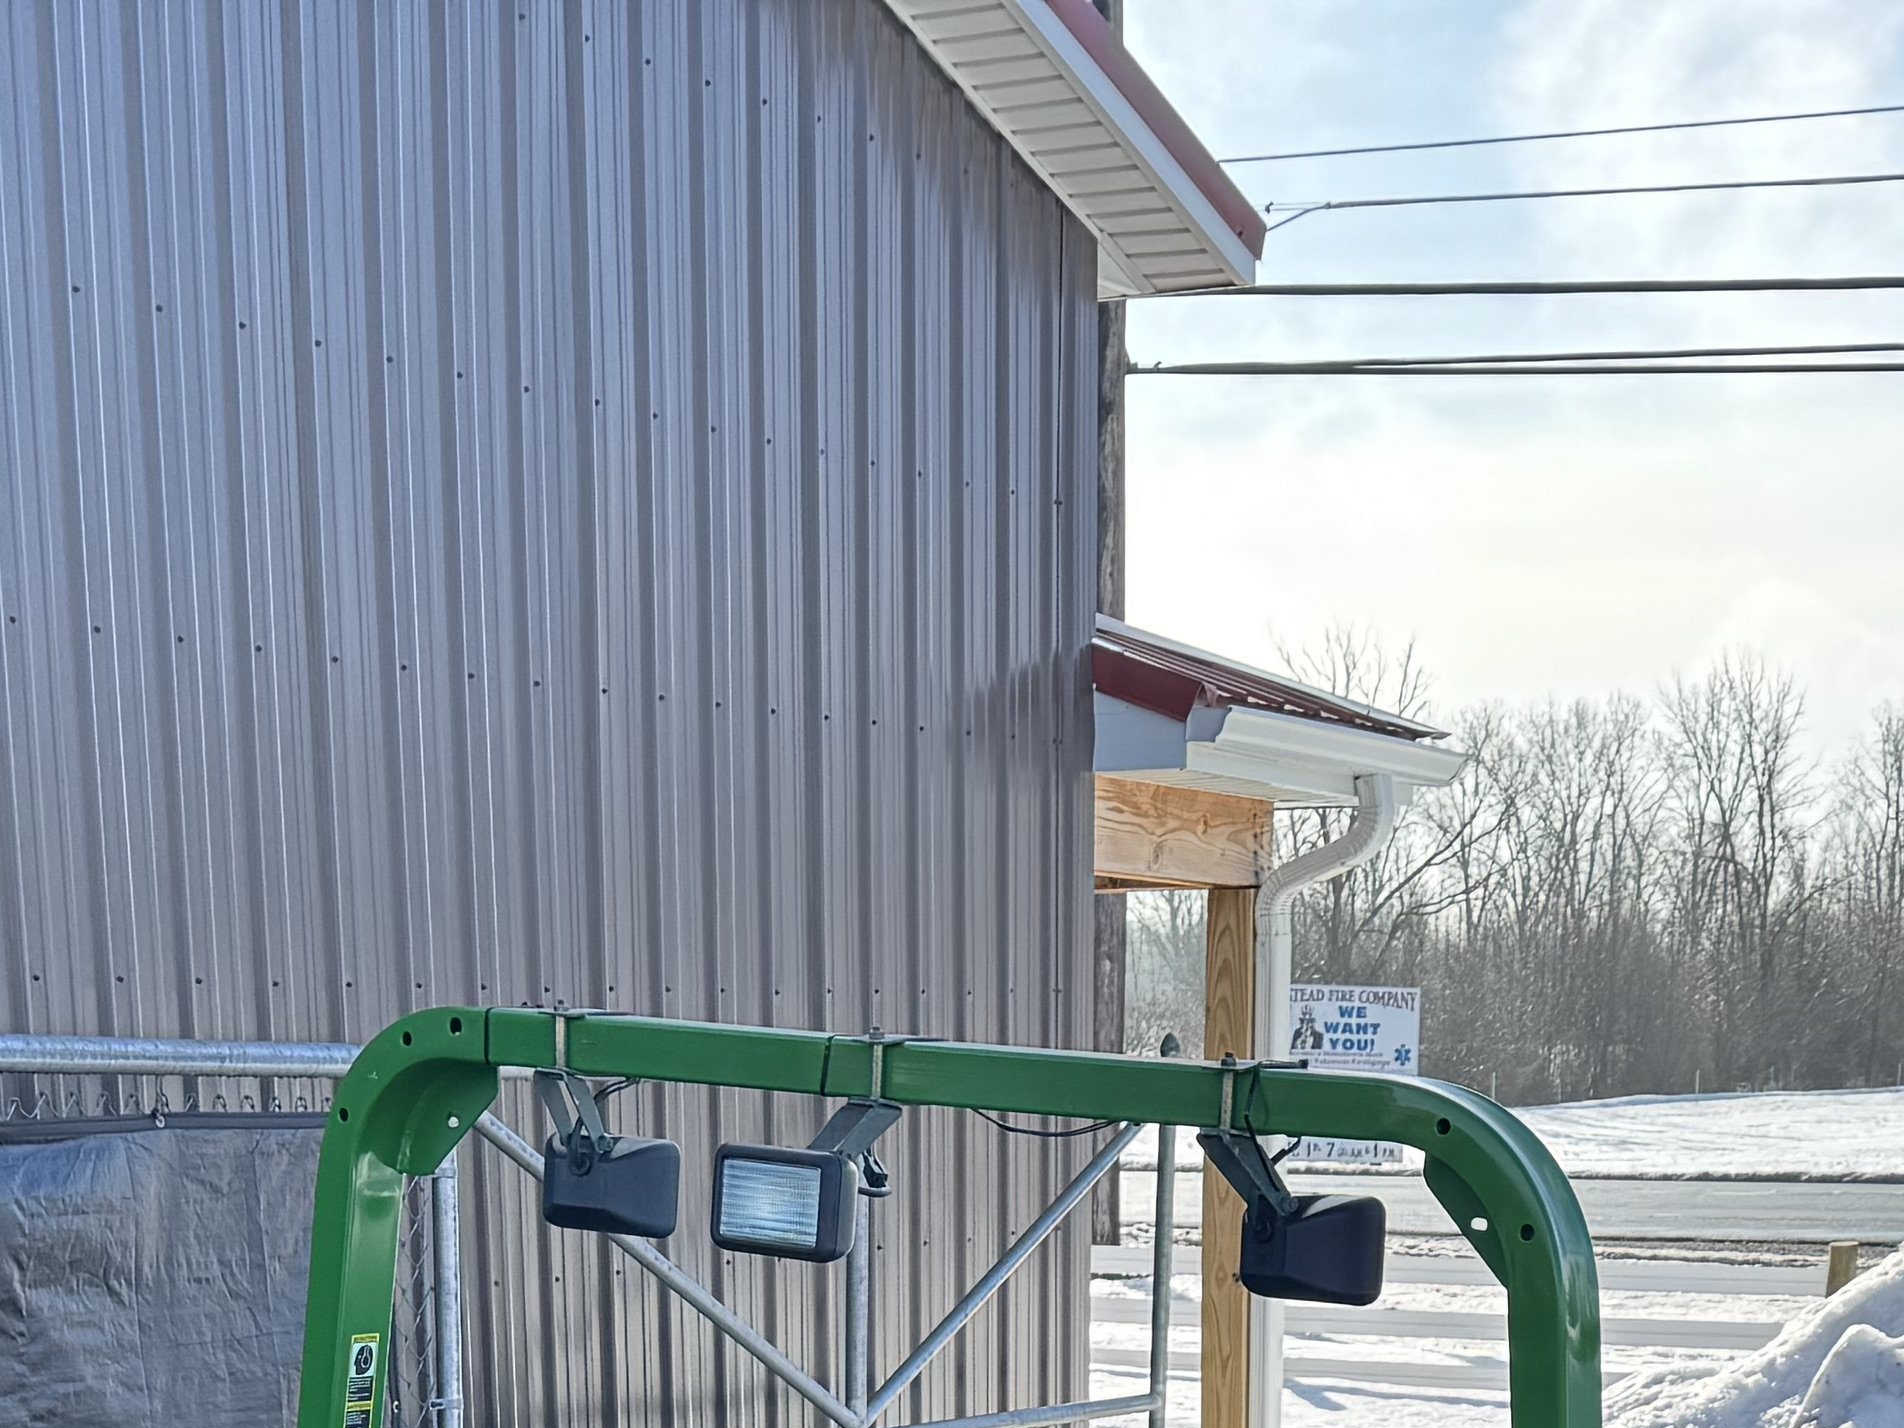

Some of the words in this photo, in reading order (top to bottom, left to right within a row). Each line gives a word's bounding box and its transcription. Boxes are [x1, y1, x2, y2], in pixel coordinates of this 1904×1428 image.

[1327, 989, 1356, 1003] FIRE
[1358, 990, 1418, 1012] COMPANY
[1338, 1005, 1368, 1019] WE
[1324, 1021, 1381, 1036] WANT
[1329, 1038, 1376, 1052] YOU!
